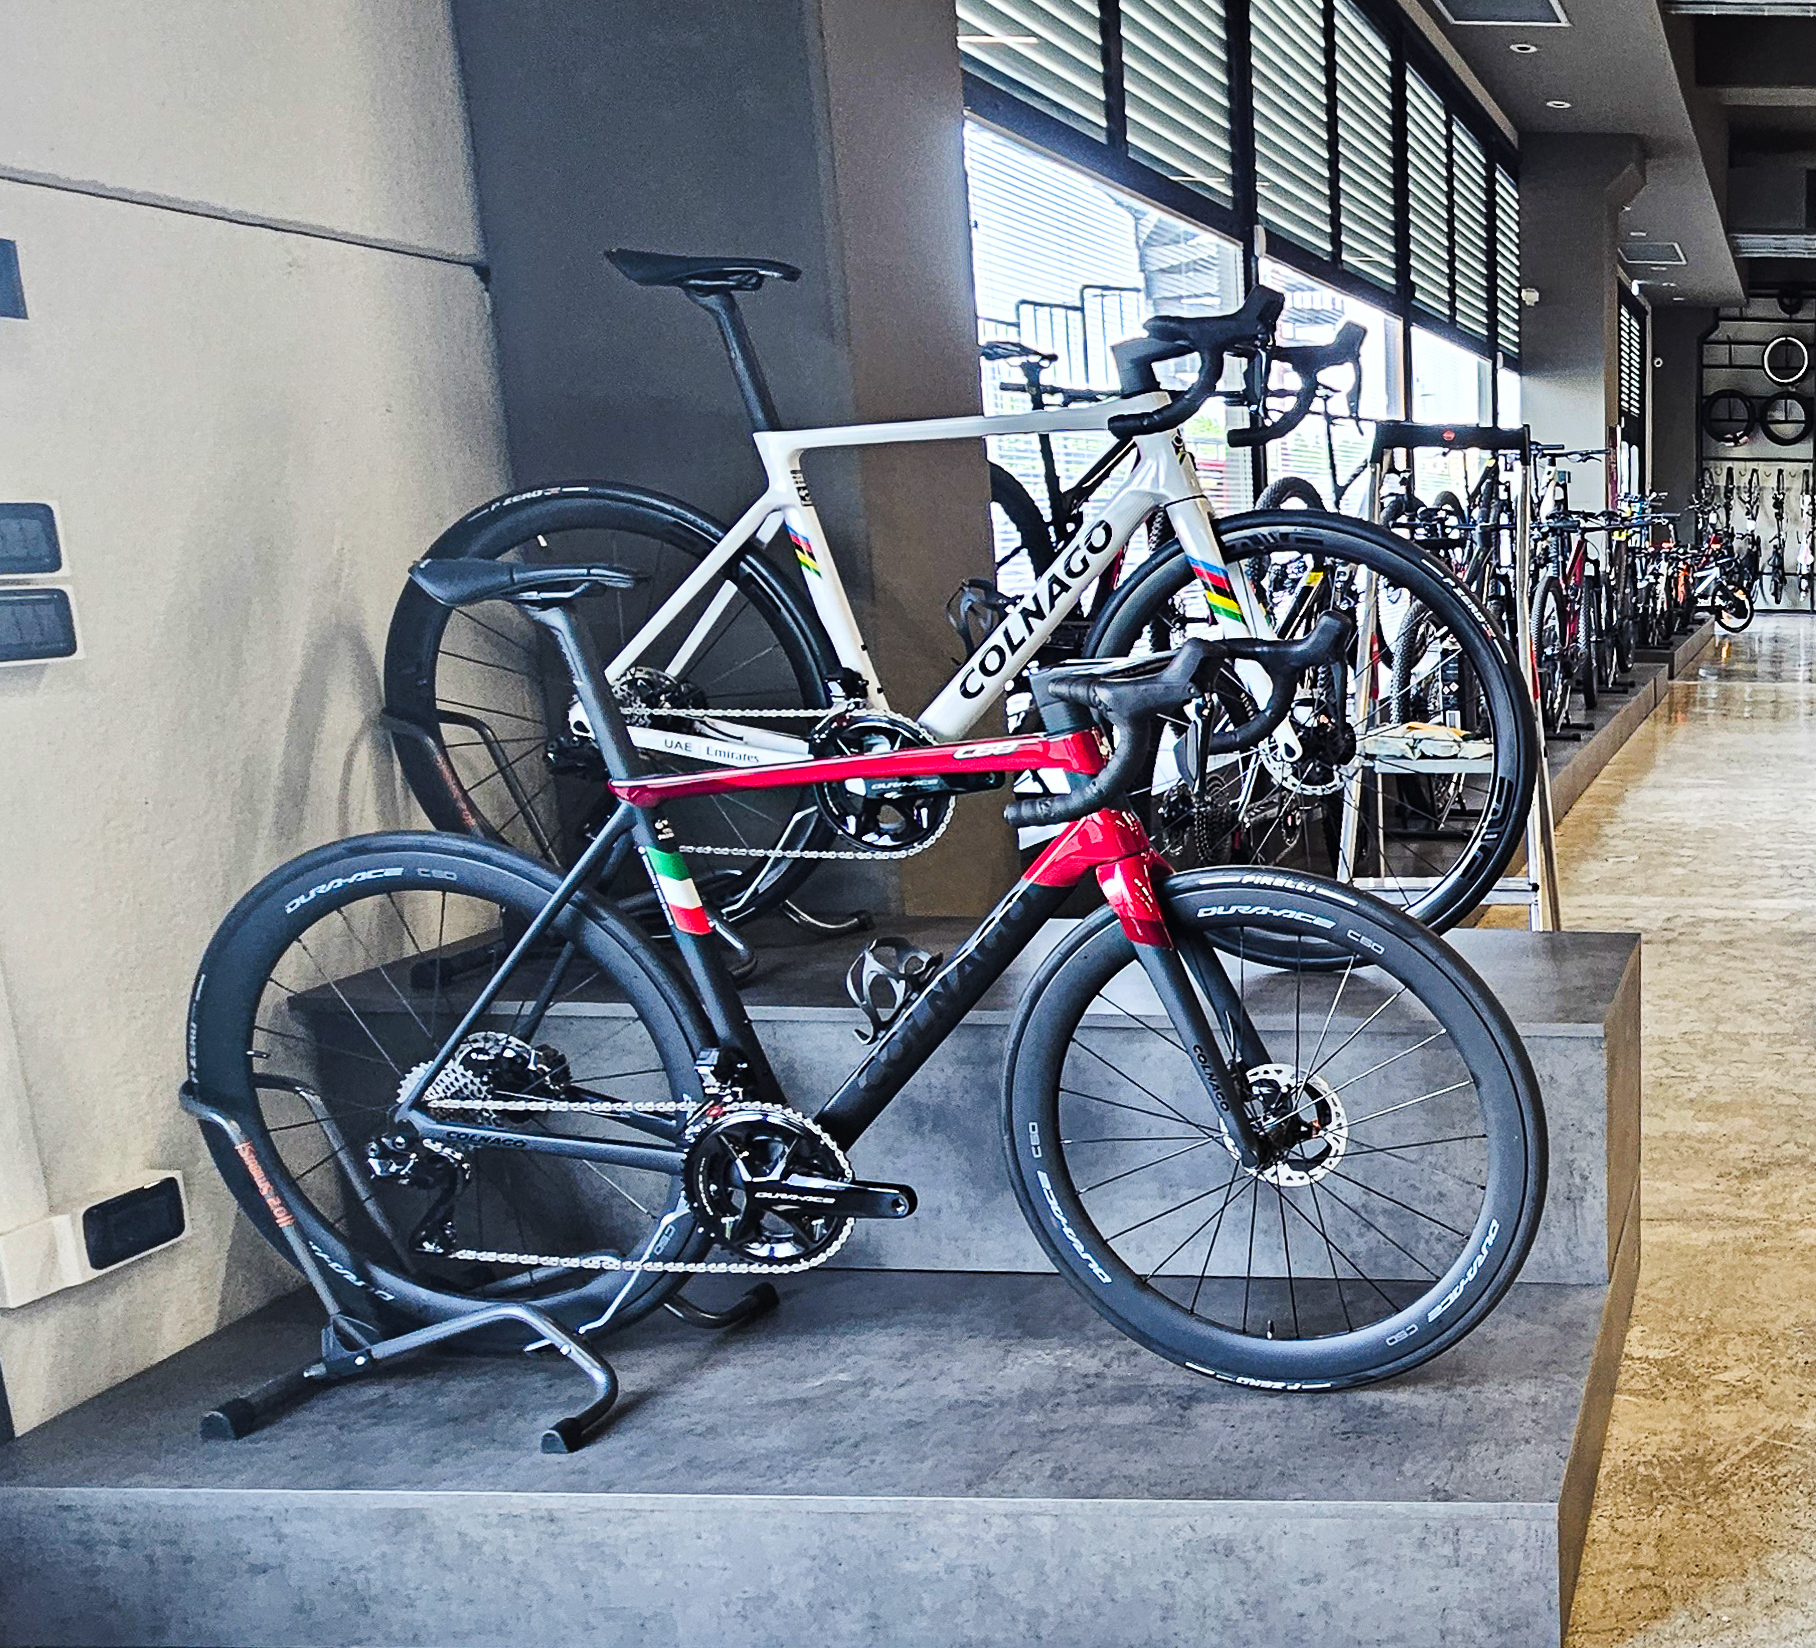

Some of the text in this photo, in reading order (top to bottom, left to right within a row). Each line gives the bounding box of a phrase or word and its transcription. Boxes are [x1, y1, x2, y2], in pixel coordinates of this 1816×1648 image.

[503, 490, 543, 506] ZERO
[959, 520, 1112, 700] COLNAGO
[664, 738, 760, 763] UAE Emirates
[285, 868, 404, 914] DURA-ACE
[1241, 875, 1316, 893] PIRELLI
[1197, 904, 1385, 955] DURA-ACE C50
[1193, 1044, 1230, 1113] COLNAGO
[446, 1130, 527, 1149] COLNAGO
[754, 1191, 836, 1204] DURA-ACE
[1037, 1170, 1112, 1284] DURA-ACE
[1428, 1219, 1499, 1323] DURA-ACE
